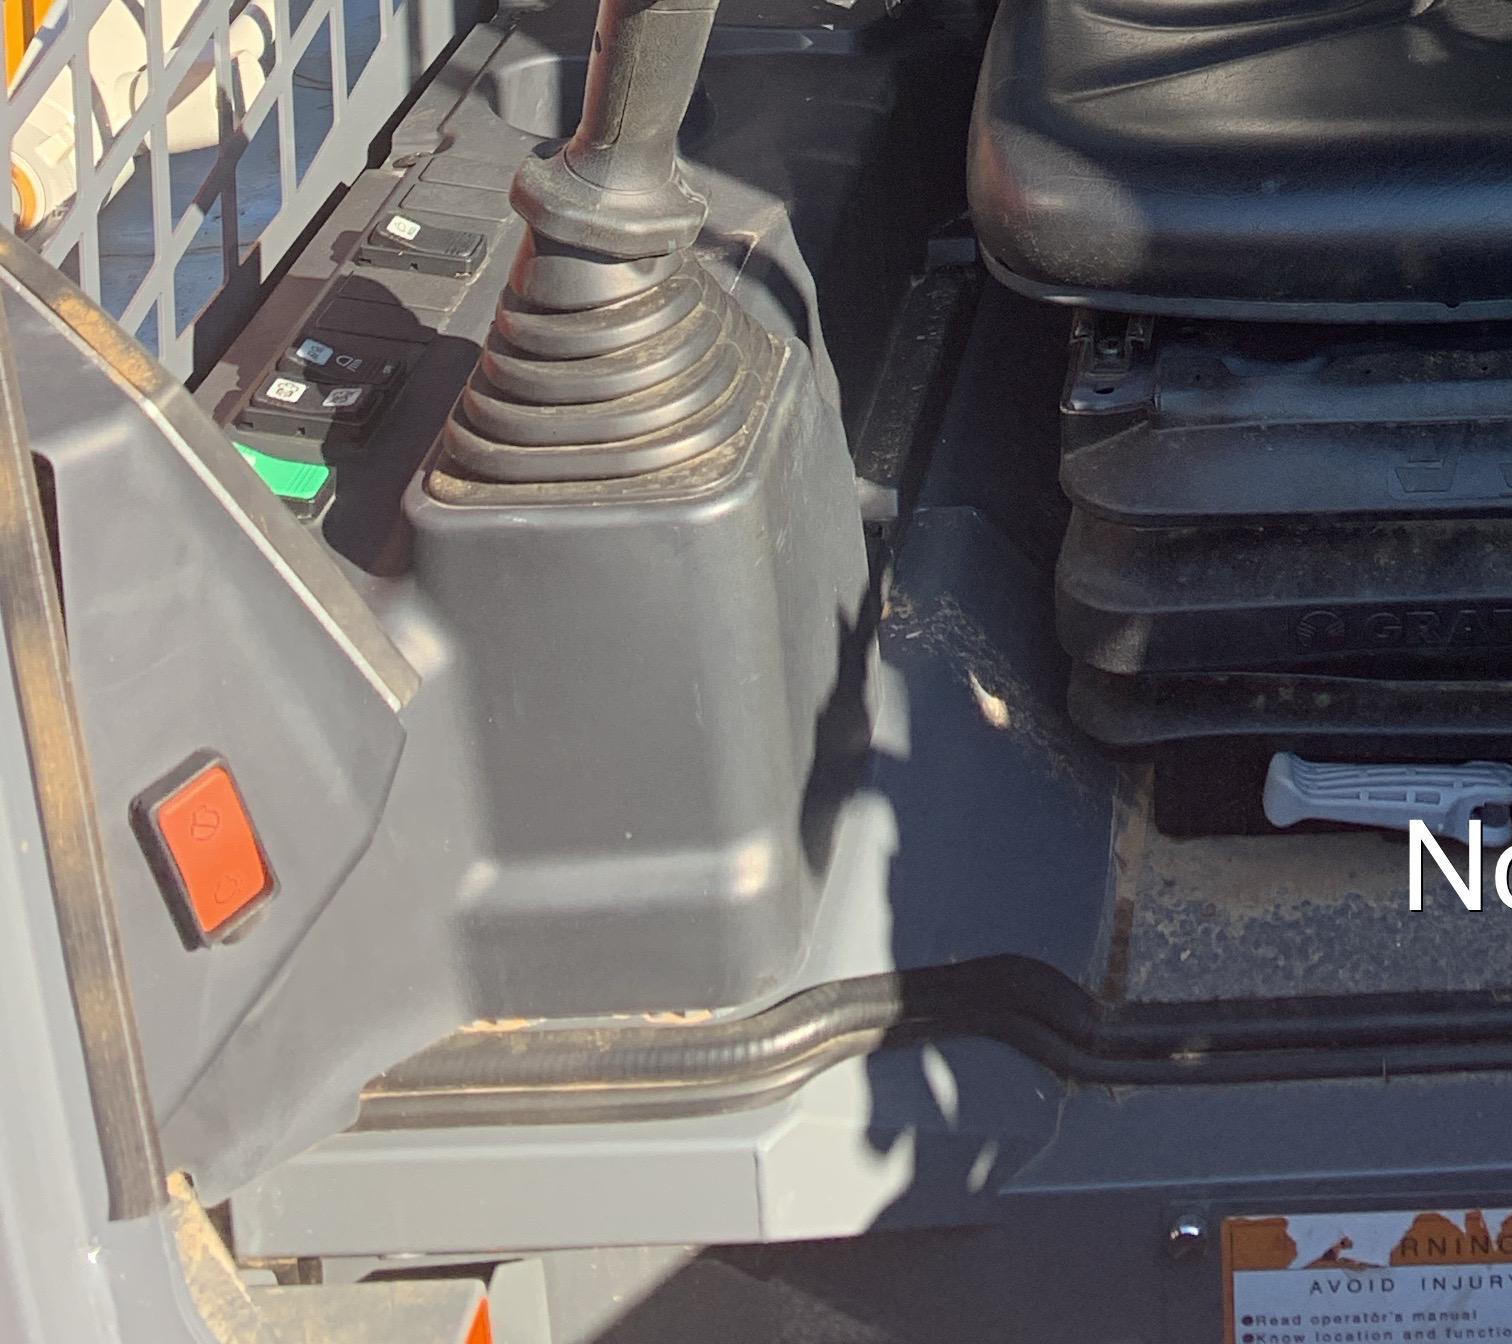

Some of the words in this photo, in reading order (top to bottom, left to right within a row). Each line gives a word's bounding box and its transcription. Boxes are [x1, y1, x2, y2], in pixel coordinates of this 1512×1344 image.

[1309, 1277, 1396, 1296] AVOID
[1256, 1315, 1301, 1327] Read
[1310, 1311, 1404, 1328] operator's
[1412, 1309, 1478, 1322] manual
[1256, 1332, 1306, 1344] Know
[1314, 1329, 1394, 1343] location
[1402, 1327, 1437, 1341] and
